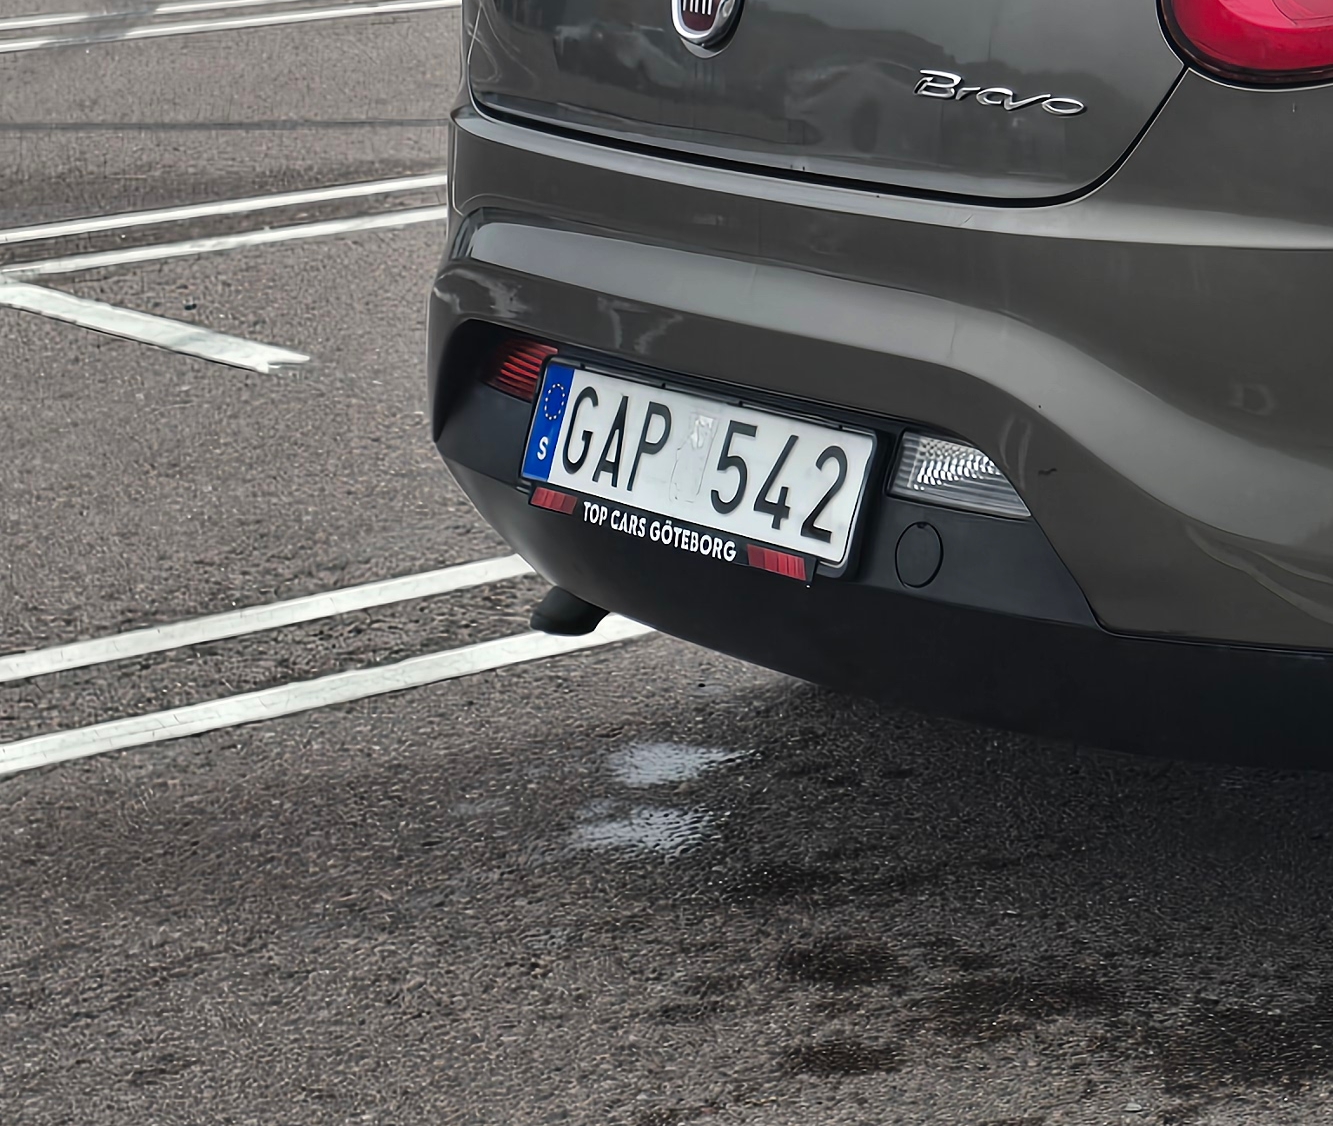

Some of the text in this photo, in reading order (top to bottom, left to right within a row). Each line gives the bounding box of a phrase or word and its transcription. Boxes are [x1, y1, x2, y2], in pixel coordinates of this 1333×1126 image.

[913, 69, 1085, 115] Bravo
[536, 436, 549, 462] S
[562, 385, 849, 544] GAP 542
[583, 500, 738, 564] TOP CARS GÖTEBORG
